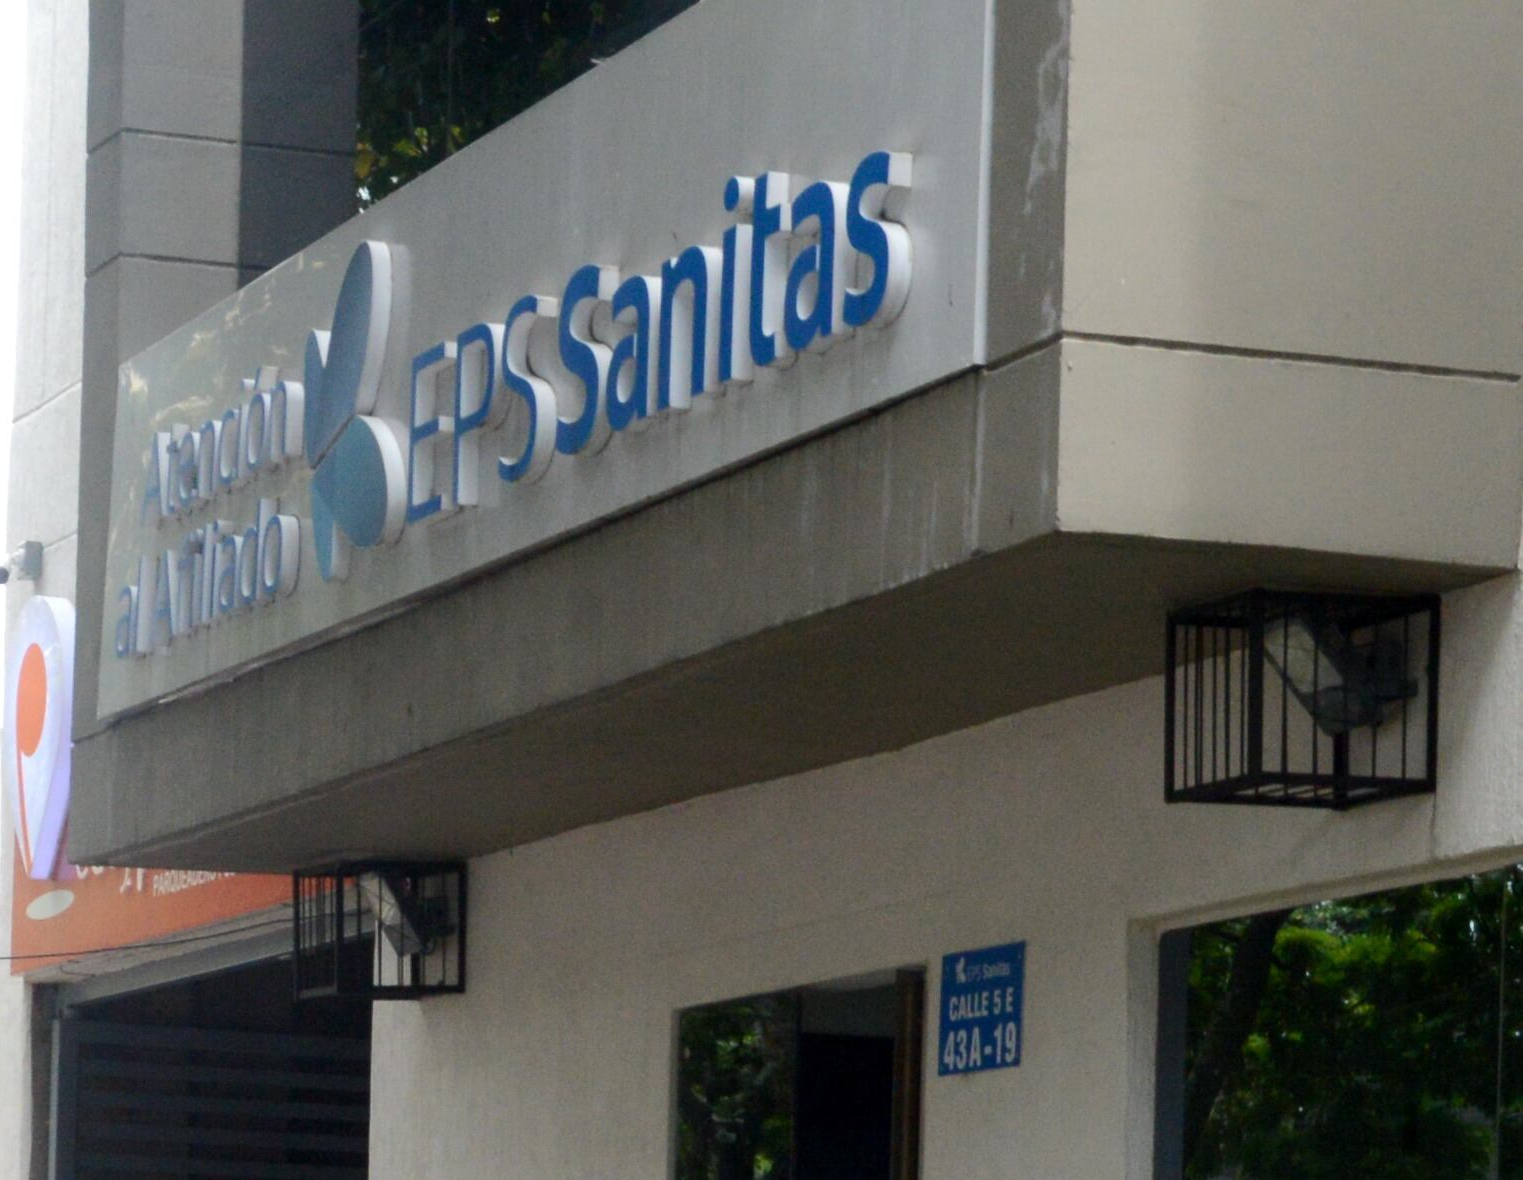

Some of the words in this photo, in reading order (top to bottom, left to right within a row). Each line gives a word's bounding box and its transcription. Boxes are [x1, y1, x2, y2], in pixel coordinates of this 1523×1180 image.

[407, 294, 557, 525] EPS
[556, 150, 913, 457] Sanitas
[141, 365, 305, 528] Atención
[116, 550, 156, 658] al
[153, 497, 301, 652] Afiliado
[943, 1021, 1017, 1071] 43A-19
[948, 990, 990, 1022] CALLE
[993, 988, 1002, 1016] 5
[1005, 986, 1015, 1014] E
